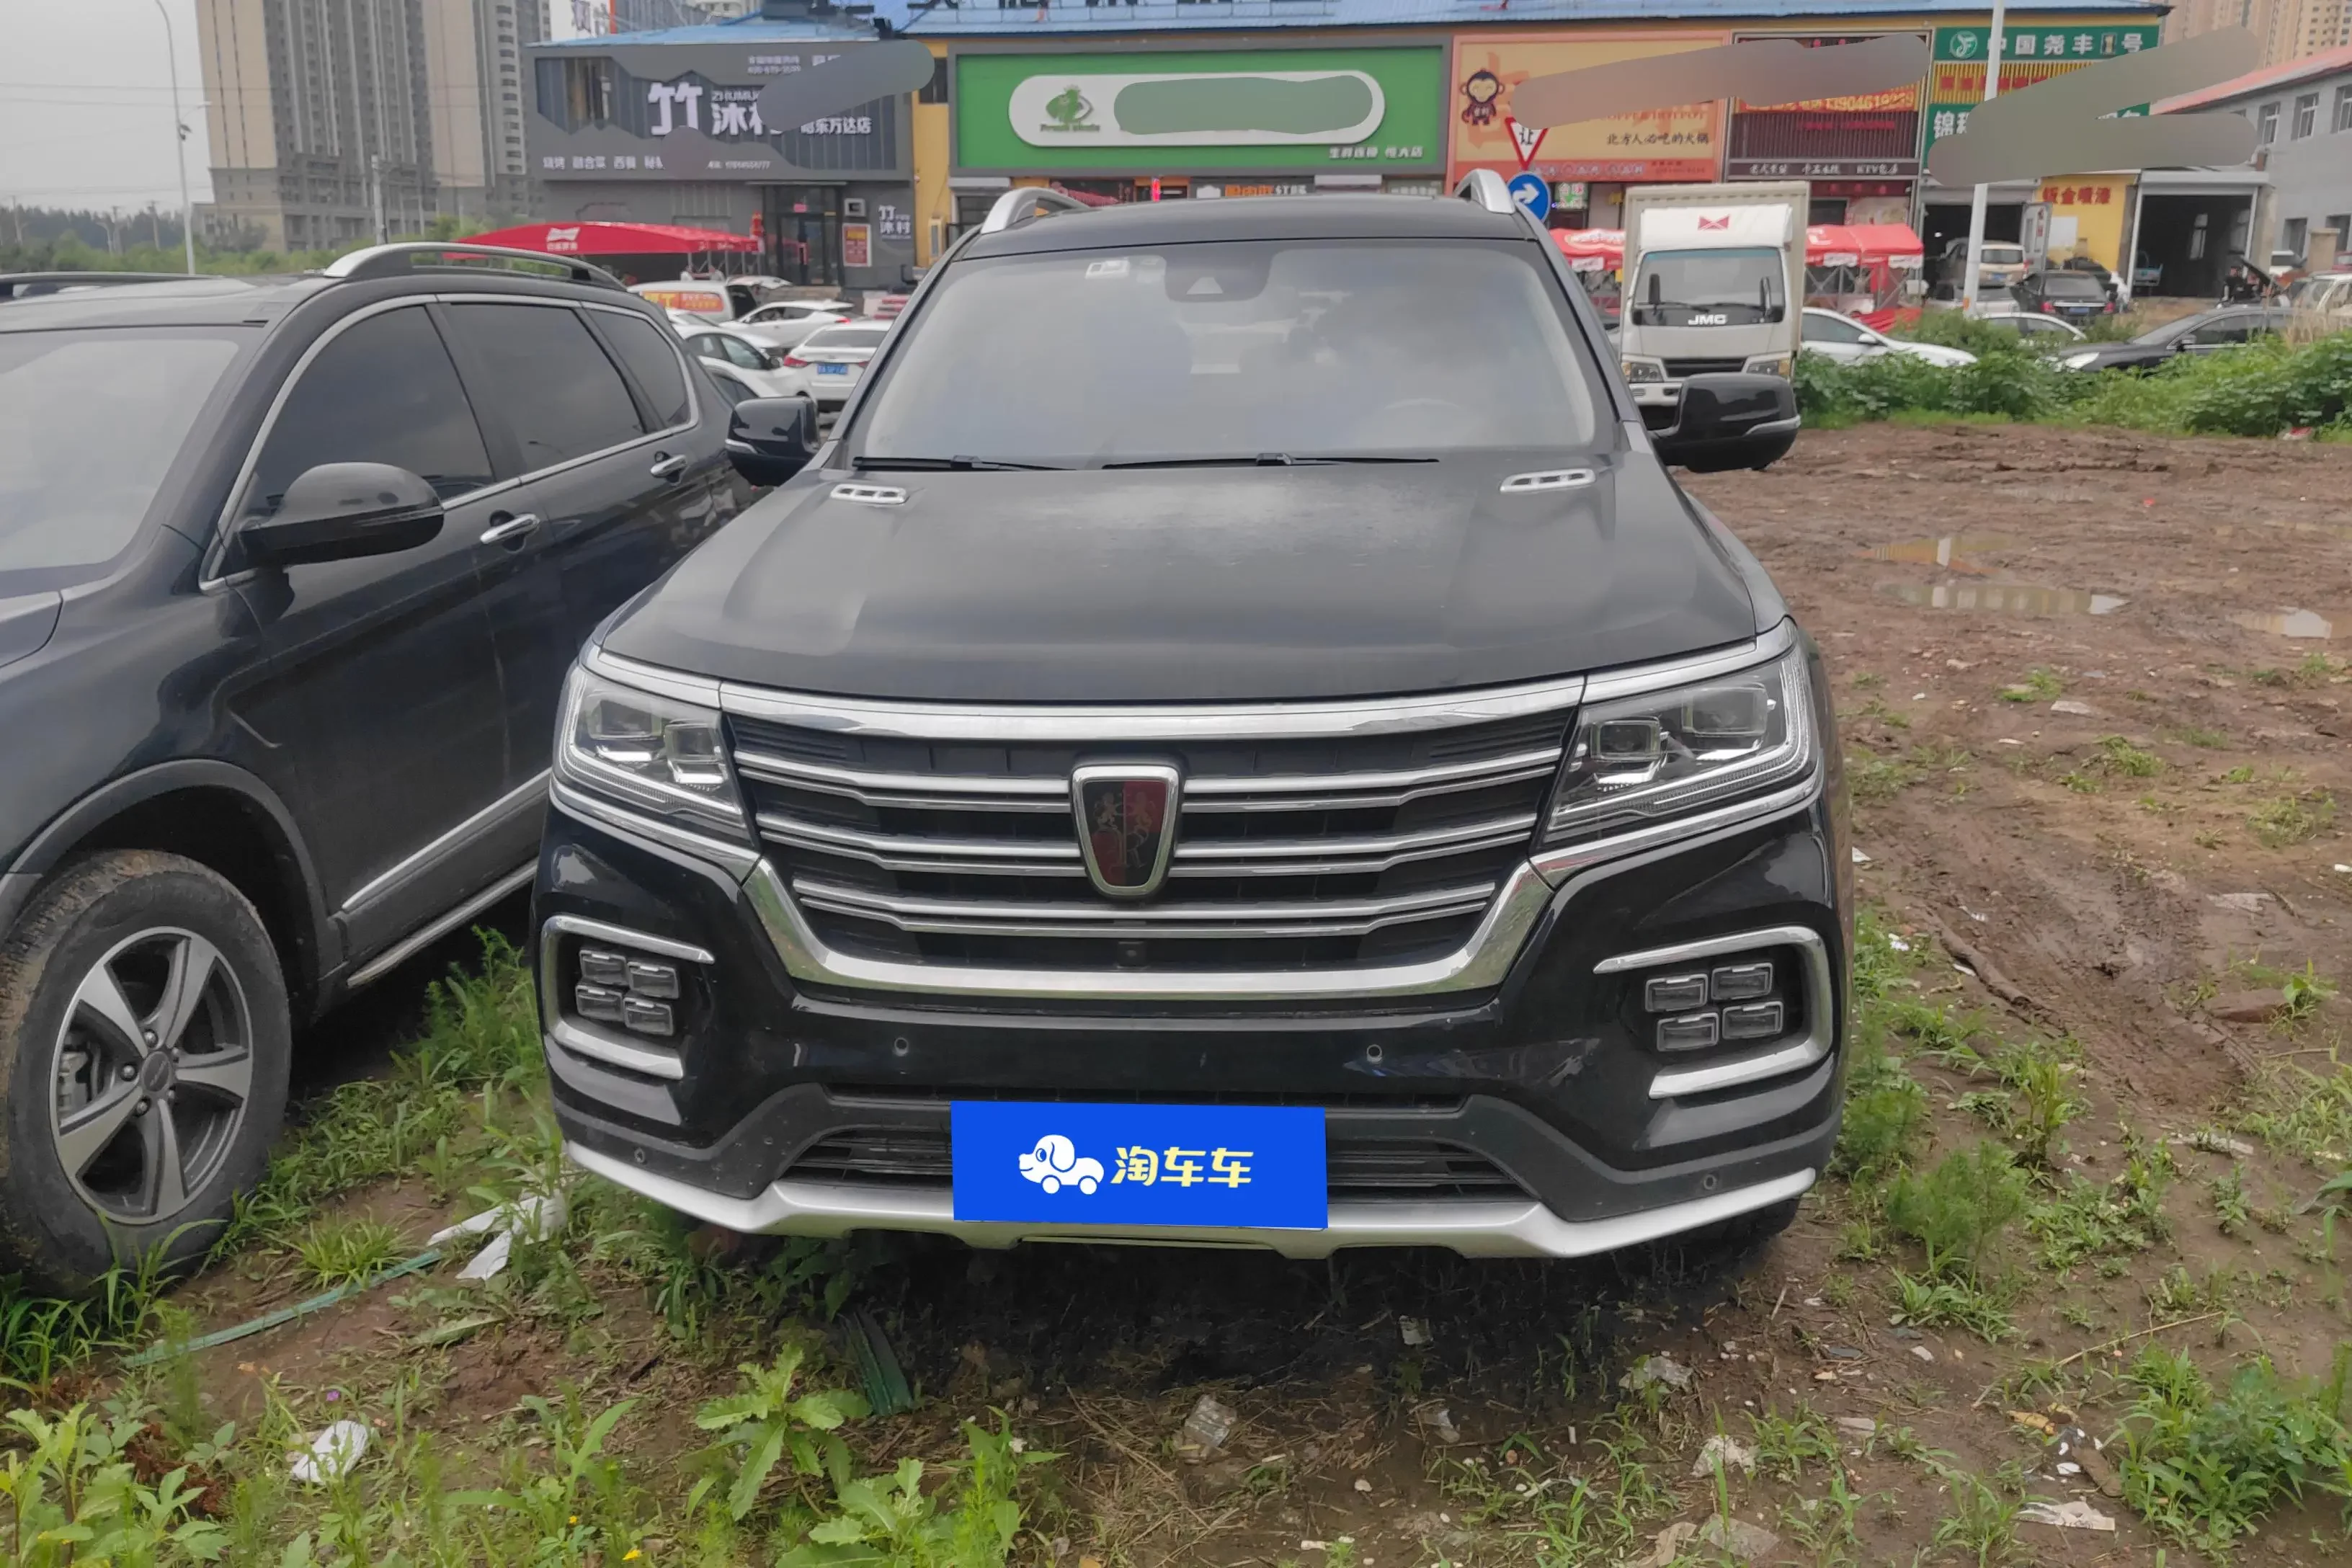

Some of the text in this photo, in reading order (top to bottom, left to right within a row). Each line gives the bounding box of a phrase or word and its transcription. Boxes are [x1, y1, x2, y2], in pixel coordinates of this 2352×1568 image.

[1606, 132, 1709, 146] 北方人必吃的火锅
[1688, 313, 1728, 325] JMC
